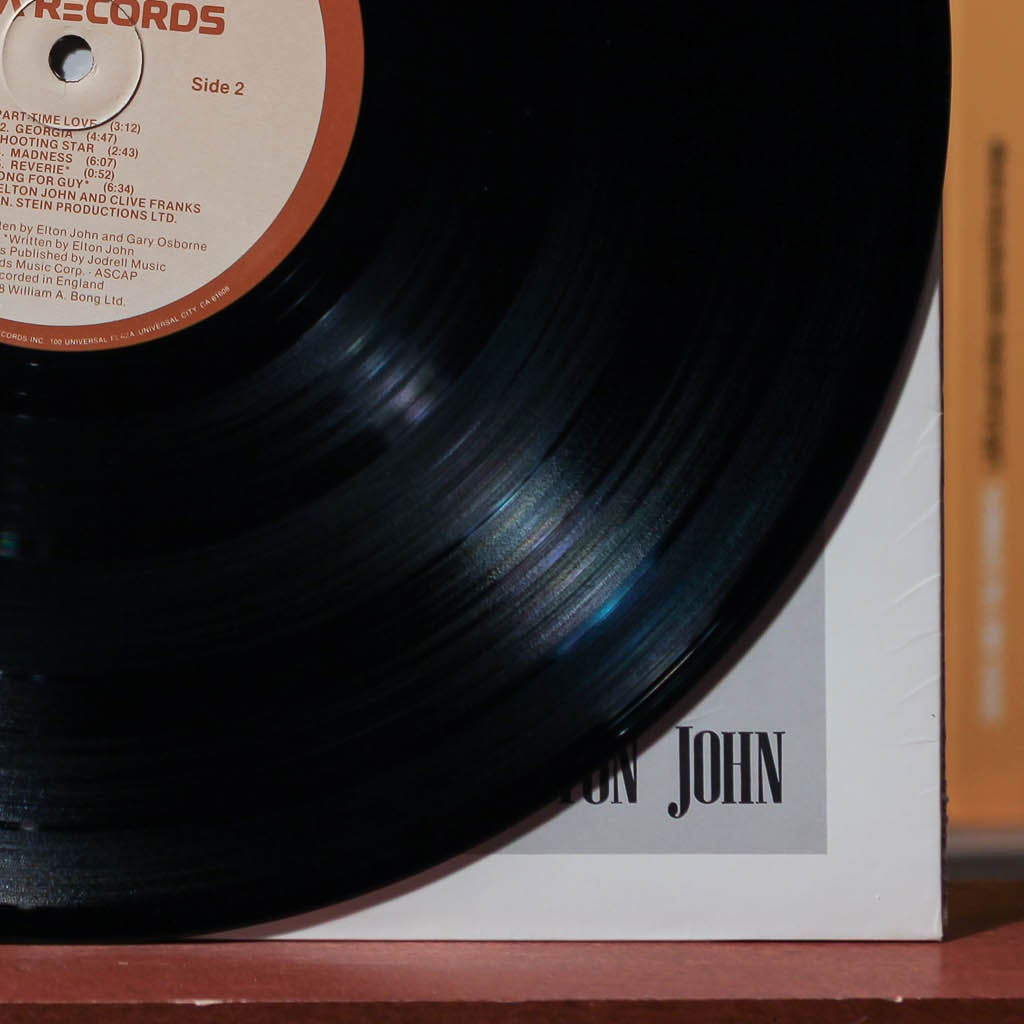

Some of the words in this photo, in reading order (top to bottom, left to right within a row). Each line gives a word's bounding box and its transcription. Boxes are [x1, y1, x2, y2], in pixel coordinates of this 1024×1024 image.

[192, 77, 230, 94] Side
[234, 82, 244, 96] 2
[0, 122, 8, 132] 2.
[15, 123, 73, 139] GEORGIA
[87, 131, 117, 145] (4:47)
[64, 115, 98, 128] LOVE
[110, 121, 140, 135] (3:12)
[11, 148, 72, 163] MADNESS
[86, 156, 116, 169] (6:07)
[62, 141, 94, 153] STAR
[108, 146, 138, 159] (2:43)
[28, 174, 54, 186] FOR
[104, 182, 134, 196] (6:34)
[84, 168, 114, 182] (0:52)
[1, 196, 12, 207] N.
[16, 198, 52, 210] STEIN
[56, 199, 147, 220] PRODUCTIONS
[151, 211, 176, 223] LTD.
[41, 188, 76, 200] JOHN
[79, 192, 106, 203] AND
[110, 195, 146, 208] CLIVE
[150, 199, 200, 213] FRANKS
[20, 223, 33, 239] by
[37, 224, 66, 237] Elton
[70, 228, 98, 240] John
[102, 233, 123, 243] and
[127, 234, 153, 248] Gary
[157, 237, 207, 251] Osborne
[56, 239, 68, 252] by
[73, 241, 102, 253] Elton
[105, 245, 134, 256] John
[10, 242, 68, 261] Published
[71, 253, 84, 265] by
[88, 255, 127, 268] Jodrell
[131, 259, 166, 272] Music
[16, 259, 51, 272] Music
[95, 268, 138, 280] ASCAP
[43, 274, 52, 284] in
[56, 273, 104, 290] England
[8, 284, 52, 298] William
[71, 291, 100, 306] Bong
[667, 726, 786, 819] JOHN
